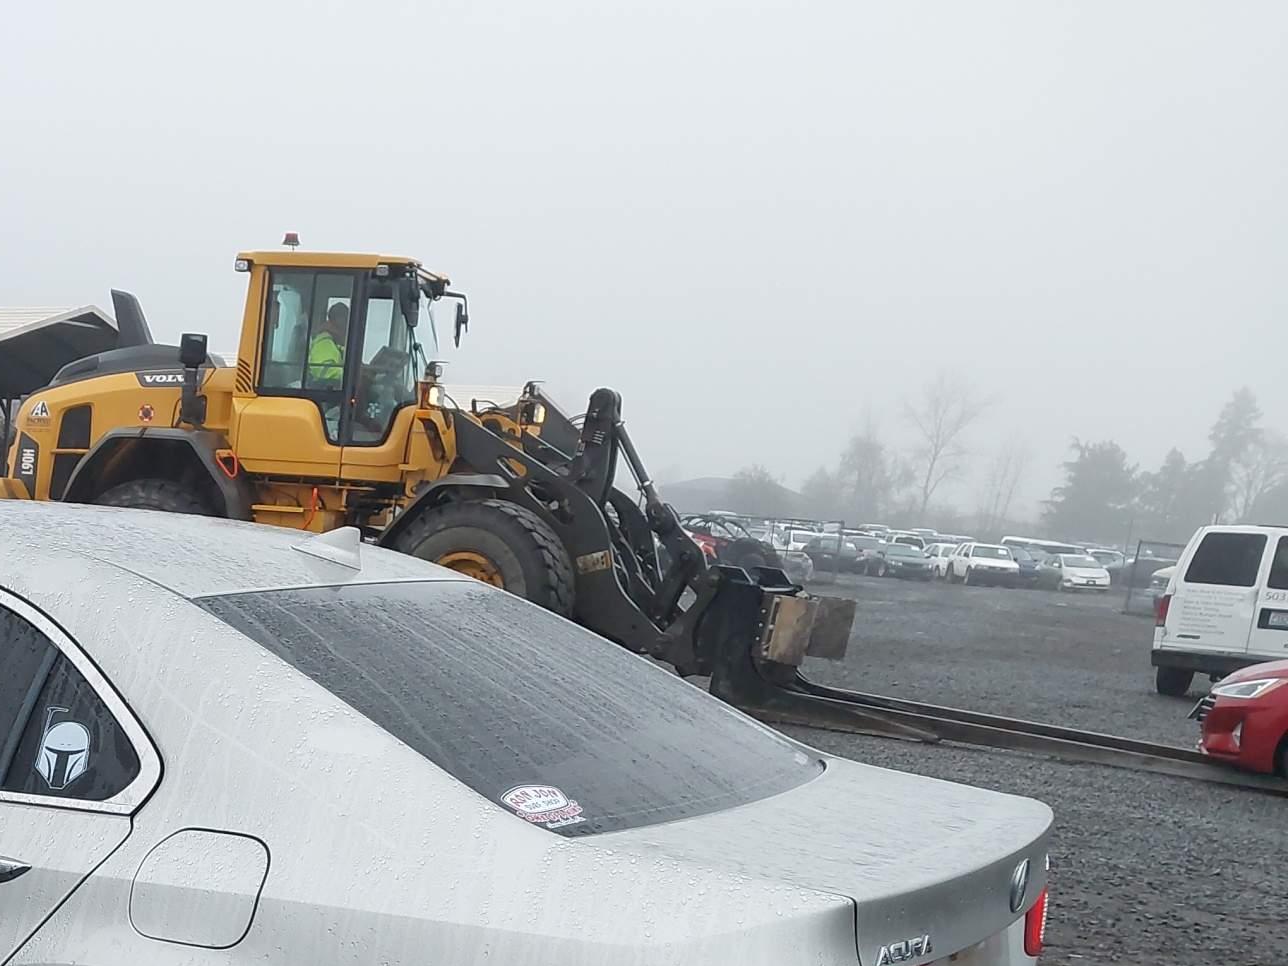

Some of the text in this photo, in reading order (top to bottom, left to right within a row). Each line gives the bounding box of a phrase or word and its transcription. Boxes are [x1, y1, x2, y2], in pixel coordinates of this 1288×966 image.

[143, 374, 185, 383] VOLV
[21, 448, 36, 476] L90H
[510, 789, 559, 807] RON JON
